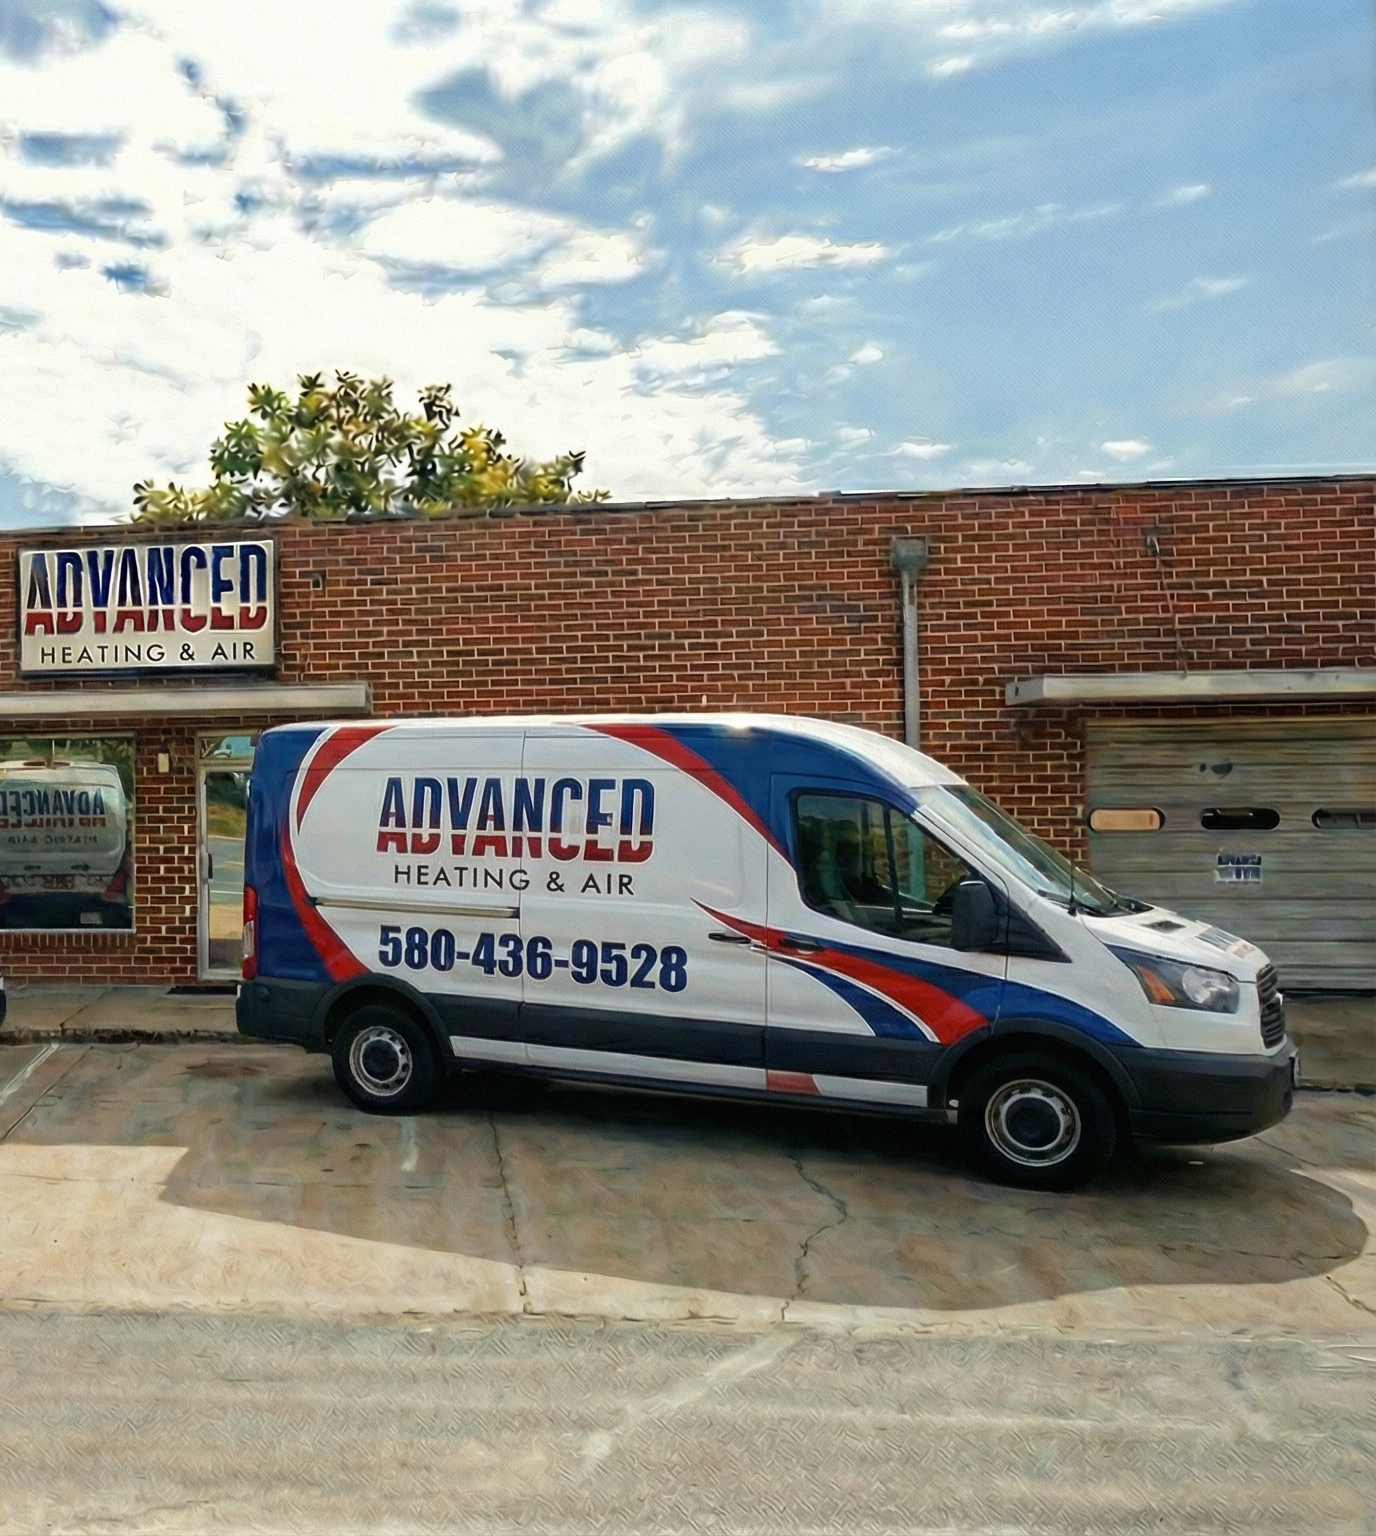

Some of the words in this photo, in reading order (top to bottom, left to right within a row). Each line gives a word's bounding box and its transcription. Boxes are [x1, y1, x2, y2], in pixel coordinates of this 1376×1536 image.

[24, 543, 267, 636] ADVANCED
[41, 643, 165, 664] HEATING
[180, 643, 195, 661] &
[211, 641, 256, 660] AIR
[376, 776, 656, 864] ADVANCED
[394, 864, 531, 891] HEATING
[546, 871, 565, 892] &
[581, 874, 635, 896] AIR
[378, 924, 688, 993] 580-436-9528
